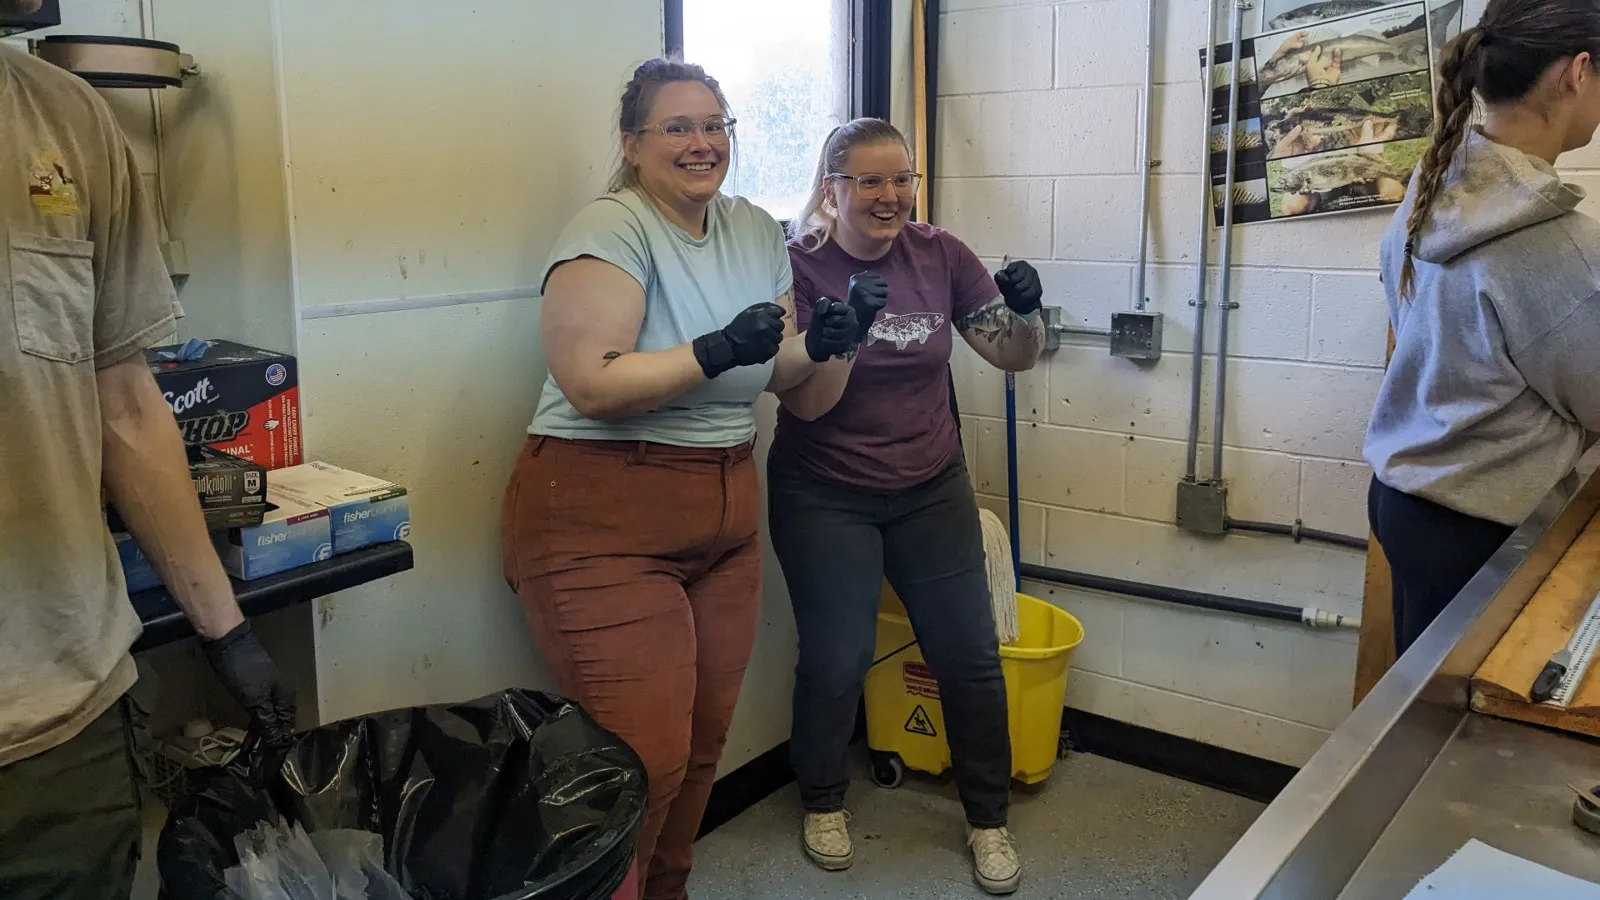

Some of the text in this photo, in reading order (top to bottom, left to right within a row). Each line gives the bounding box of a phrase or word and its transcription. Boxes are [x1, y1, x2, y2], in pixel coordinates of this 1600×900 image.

[163, 377, 210, 414] Scott
[177, 411, 249, 444] HOP
[247, 479, 256, 487] M
